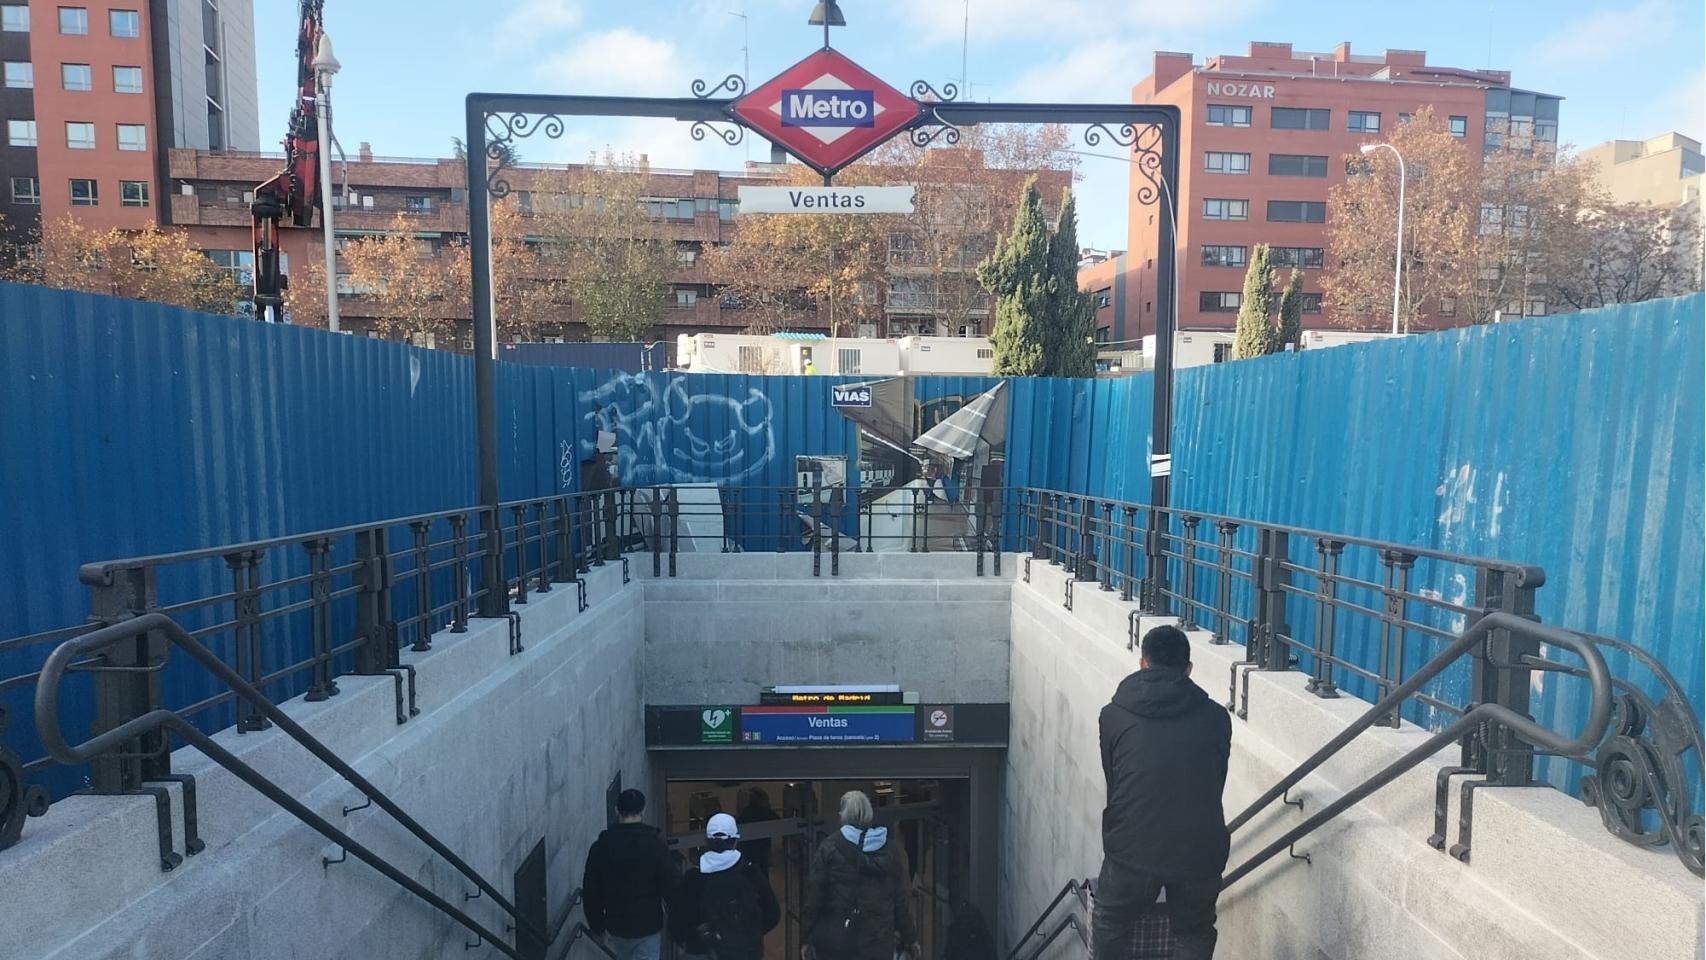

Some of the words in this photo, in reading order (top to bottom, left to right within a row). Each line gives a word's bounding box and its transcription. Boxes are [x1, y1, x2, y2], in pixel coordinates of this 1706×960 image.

[1207, 82, 1275, 98] NOZAR
[790, 94, 867, 119] Metro
[789, 191, 865, 208] Ventas
[834, 391, 869, 402] VIAS
[808, 717, 848, 728] Ventas
